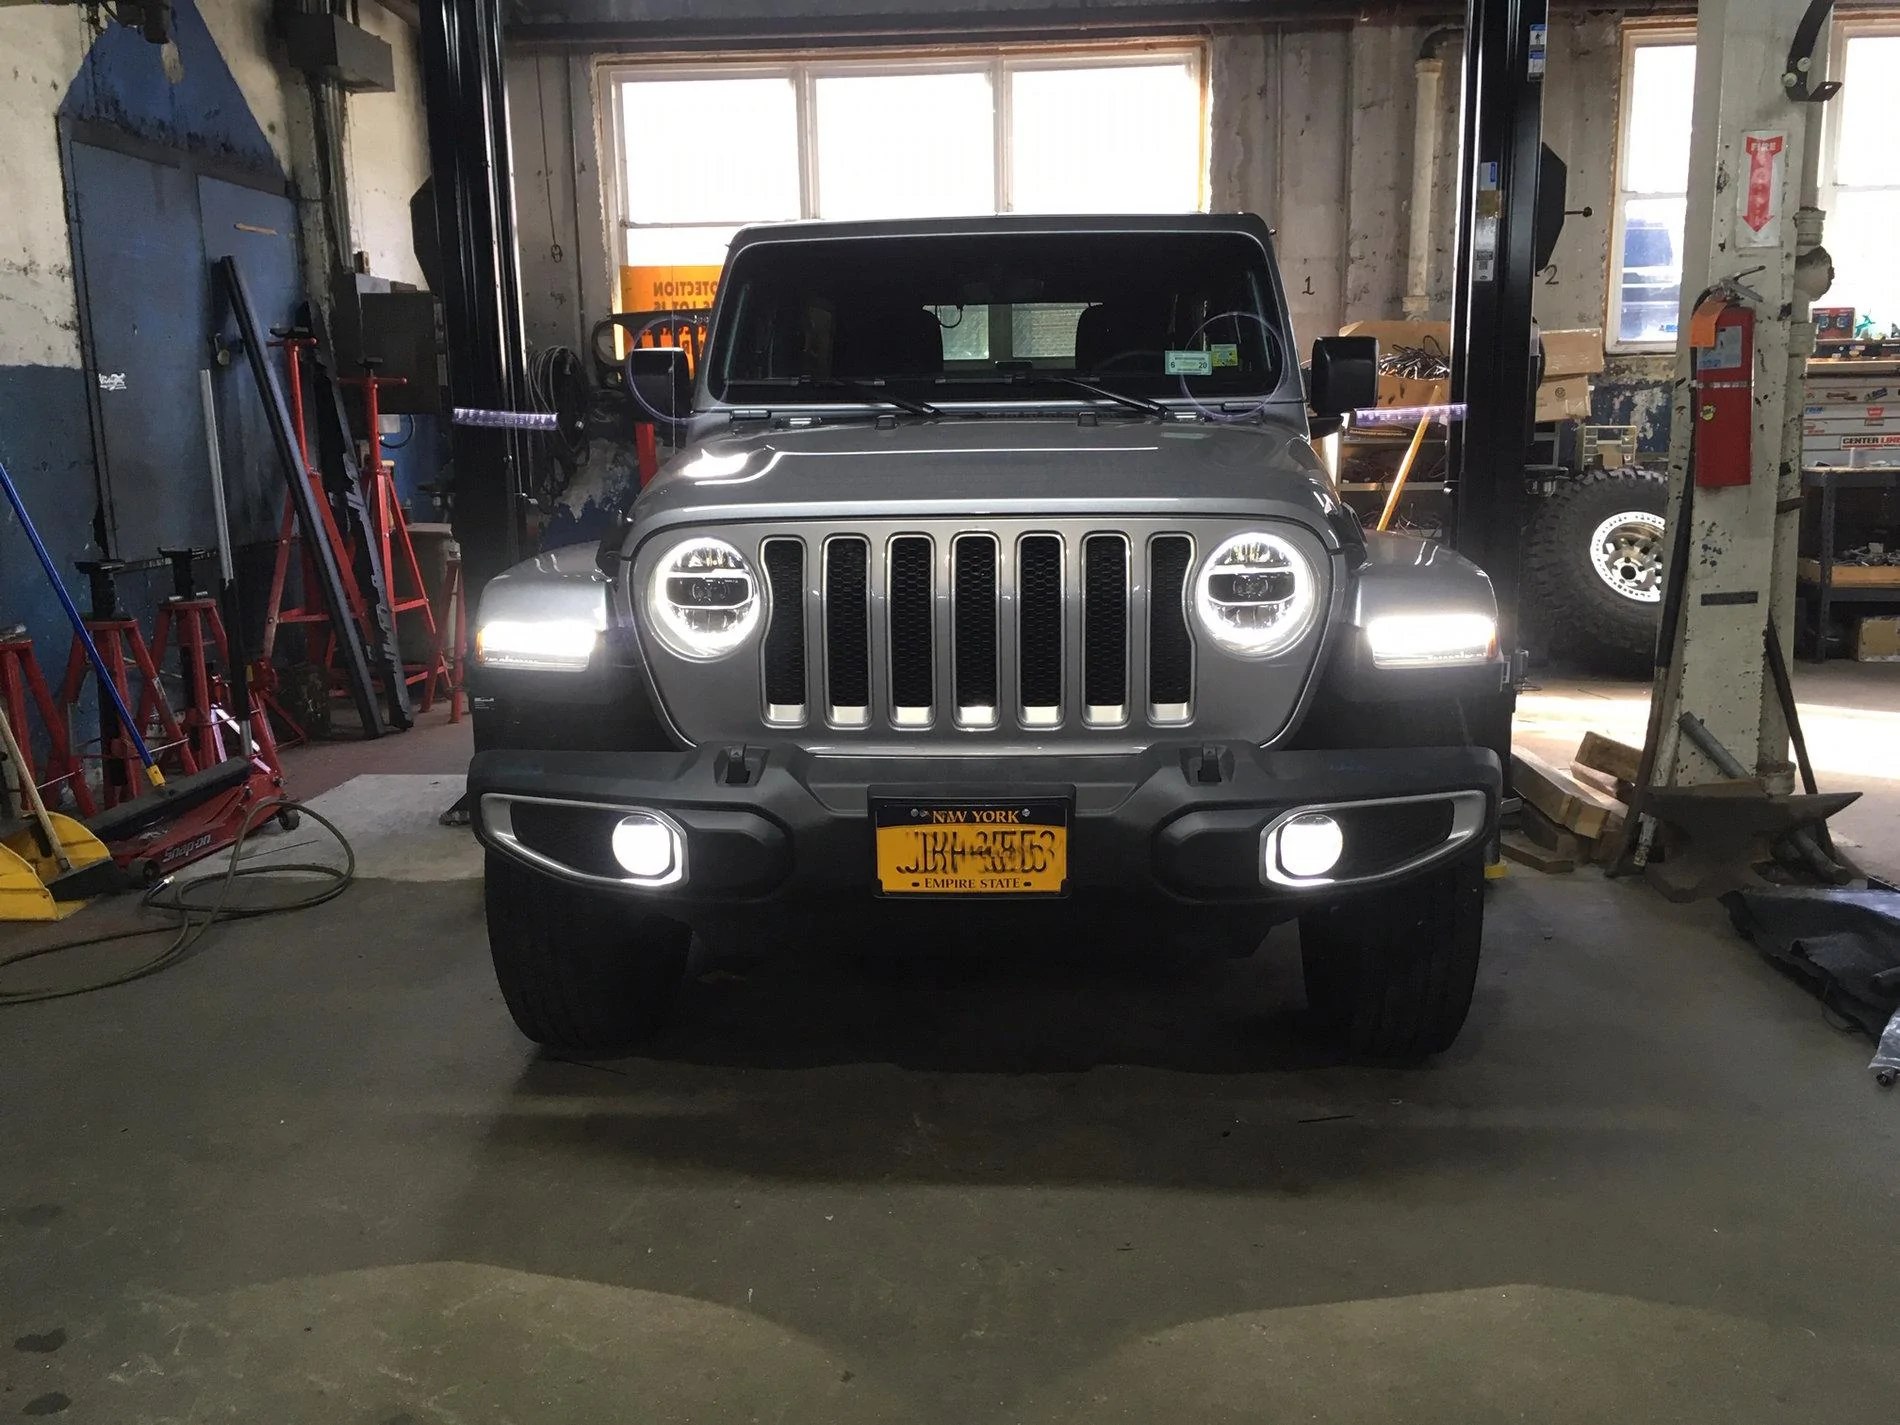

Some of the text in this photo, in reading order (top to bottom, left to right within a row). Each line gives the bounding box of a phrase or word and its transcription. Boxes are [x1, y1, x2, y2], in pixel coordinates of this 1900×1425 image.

[1750, 141, 1777, 152] FIRE
[1543, 264, 1560, 285] 2
[1302, 275, 1315, 295] 1
[971, 810, 1020, 823] YORK
[162, 834, 211, 863] Snap-on
[925, 877, 1020, 889] EMPIRE STATE
